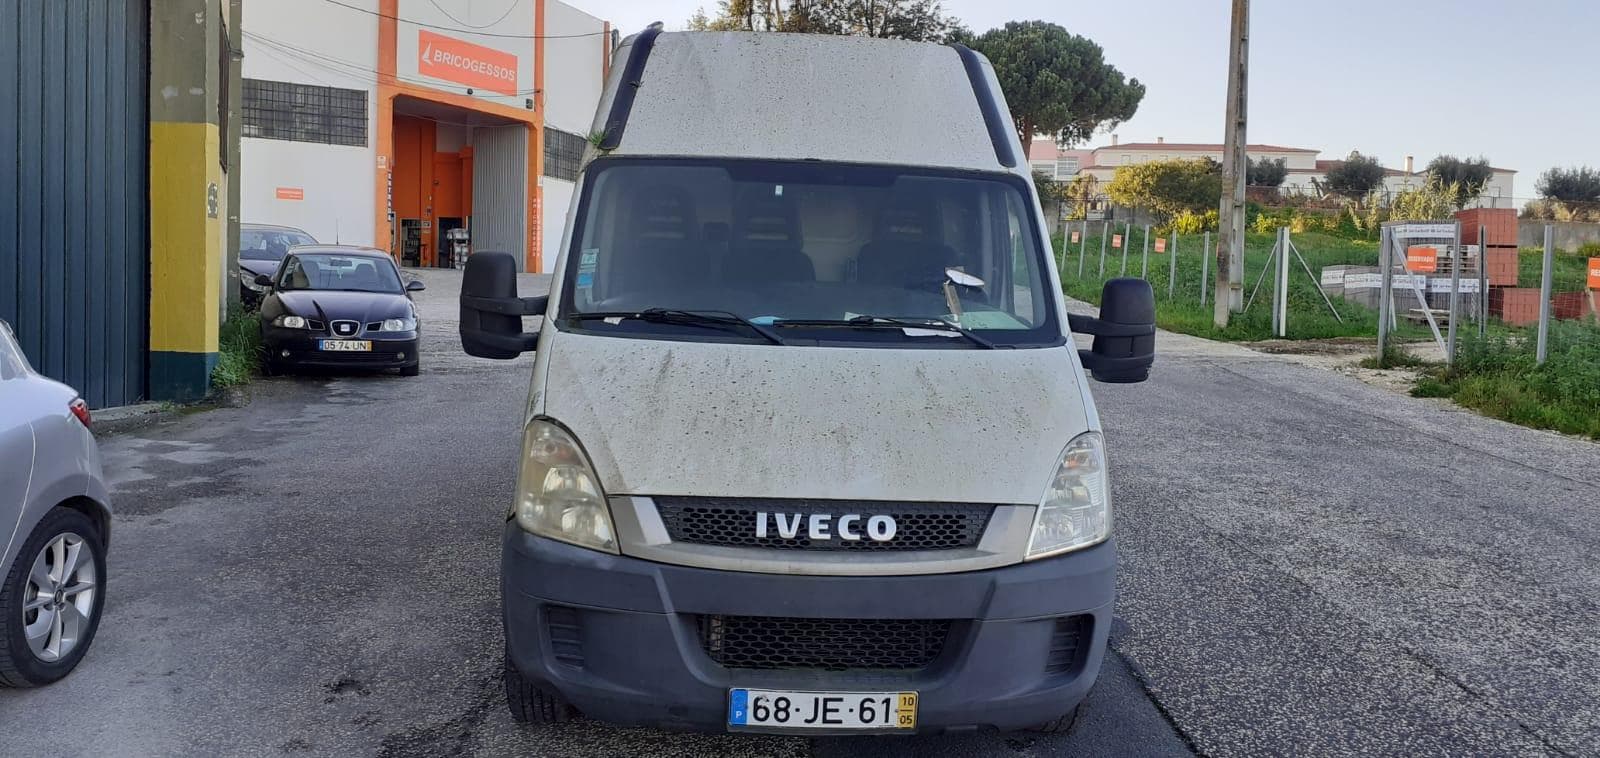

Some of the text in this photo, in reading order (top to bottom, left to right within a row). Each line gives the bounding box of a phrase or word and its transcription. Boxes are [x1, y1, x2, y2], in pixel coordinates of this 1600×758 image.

[433, 48, 515, 81] BRICOGESSOS
[755, 511, 897, 541] IVECO
[902, 696, 914, 706] 10
[735, 711, 743, 719] P
[899, 715, 913, 725] 05
